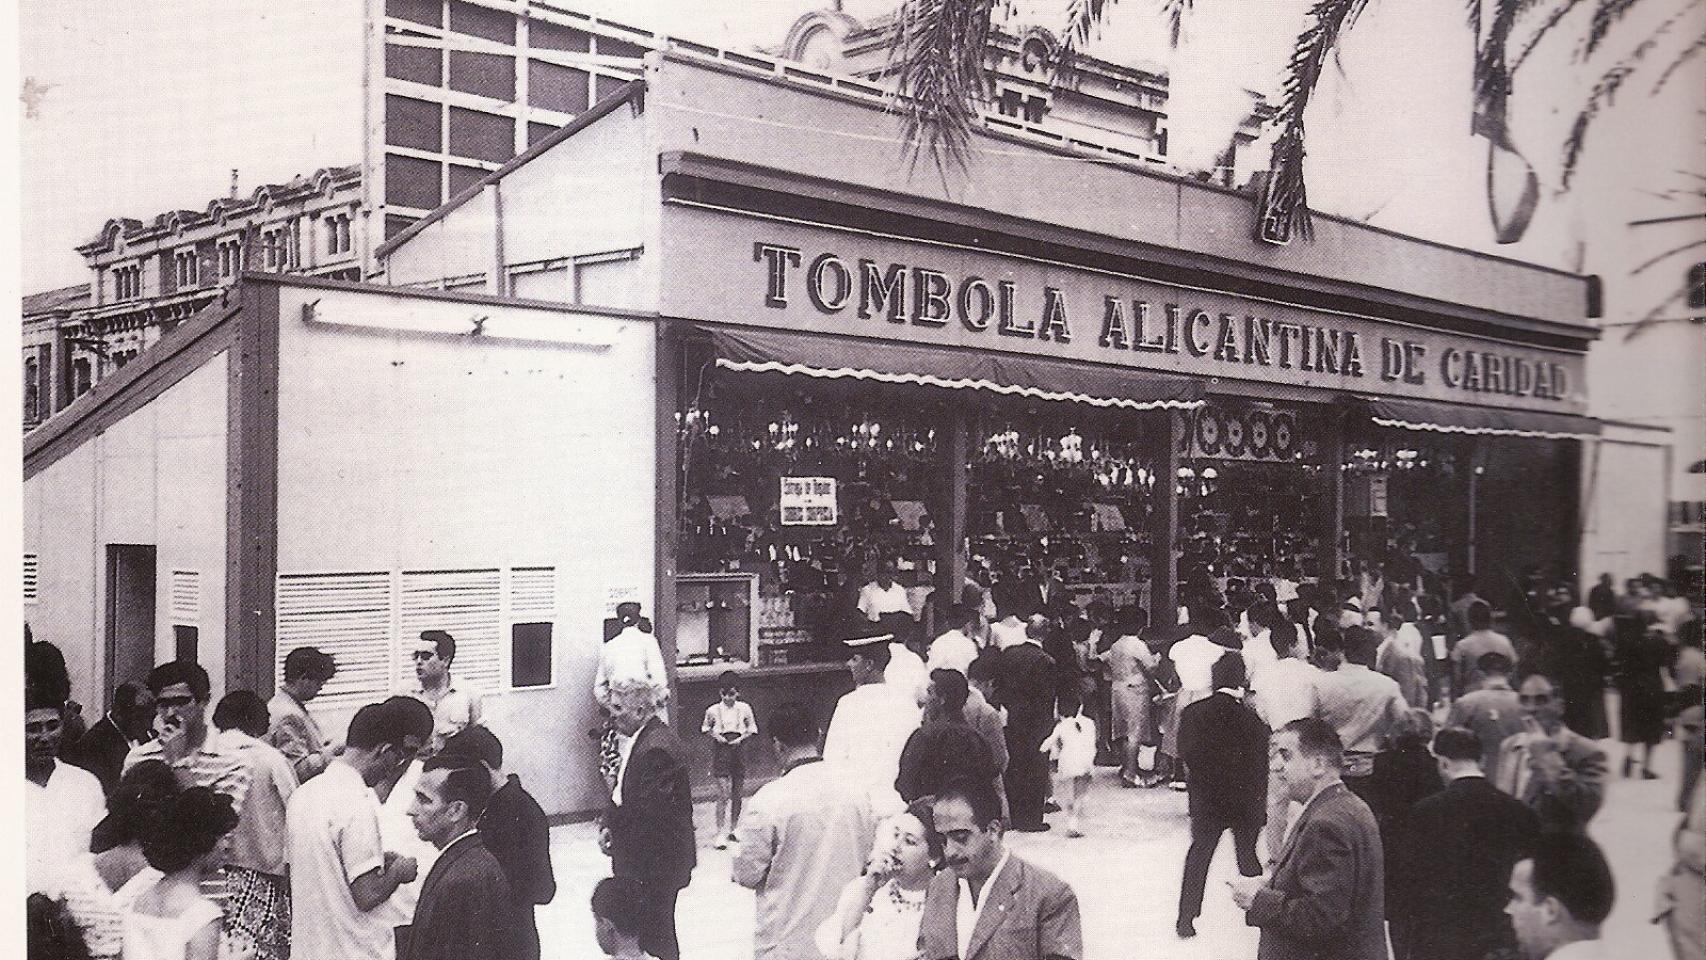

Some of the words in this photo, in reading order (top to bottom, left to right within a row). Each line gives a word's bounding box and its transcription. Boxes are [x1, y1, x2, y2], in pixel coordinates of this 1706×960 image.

[754, 242, 1071, 343] TOMBOLA
[1099, 295, 1364, 377] ALICANTINA
[1383, 338, 1427, 386] DE
[1441, 347, 1568, 402] CARIDAD
